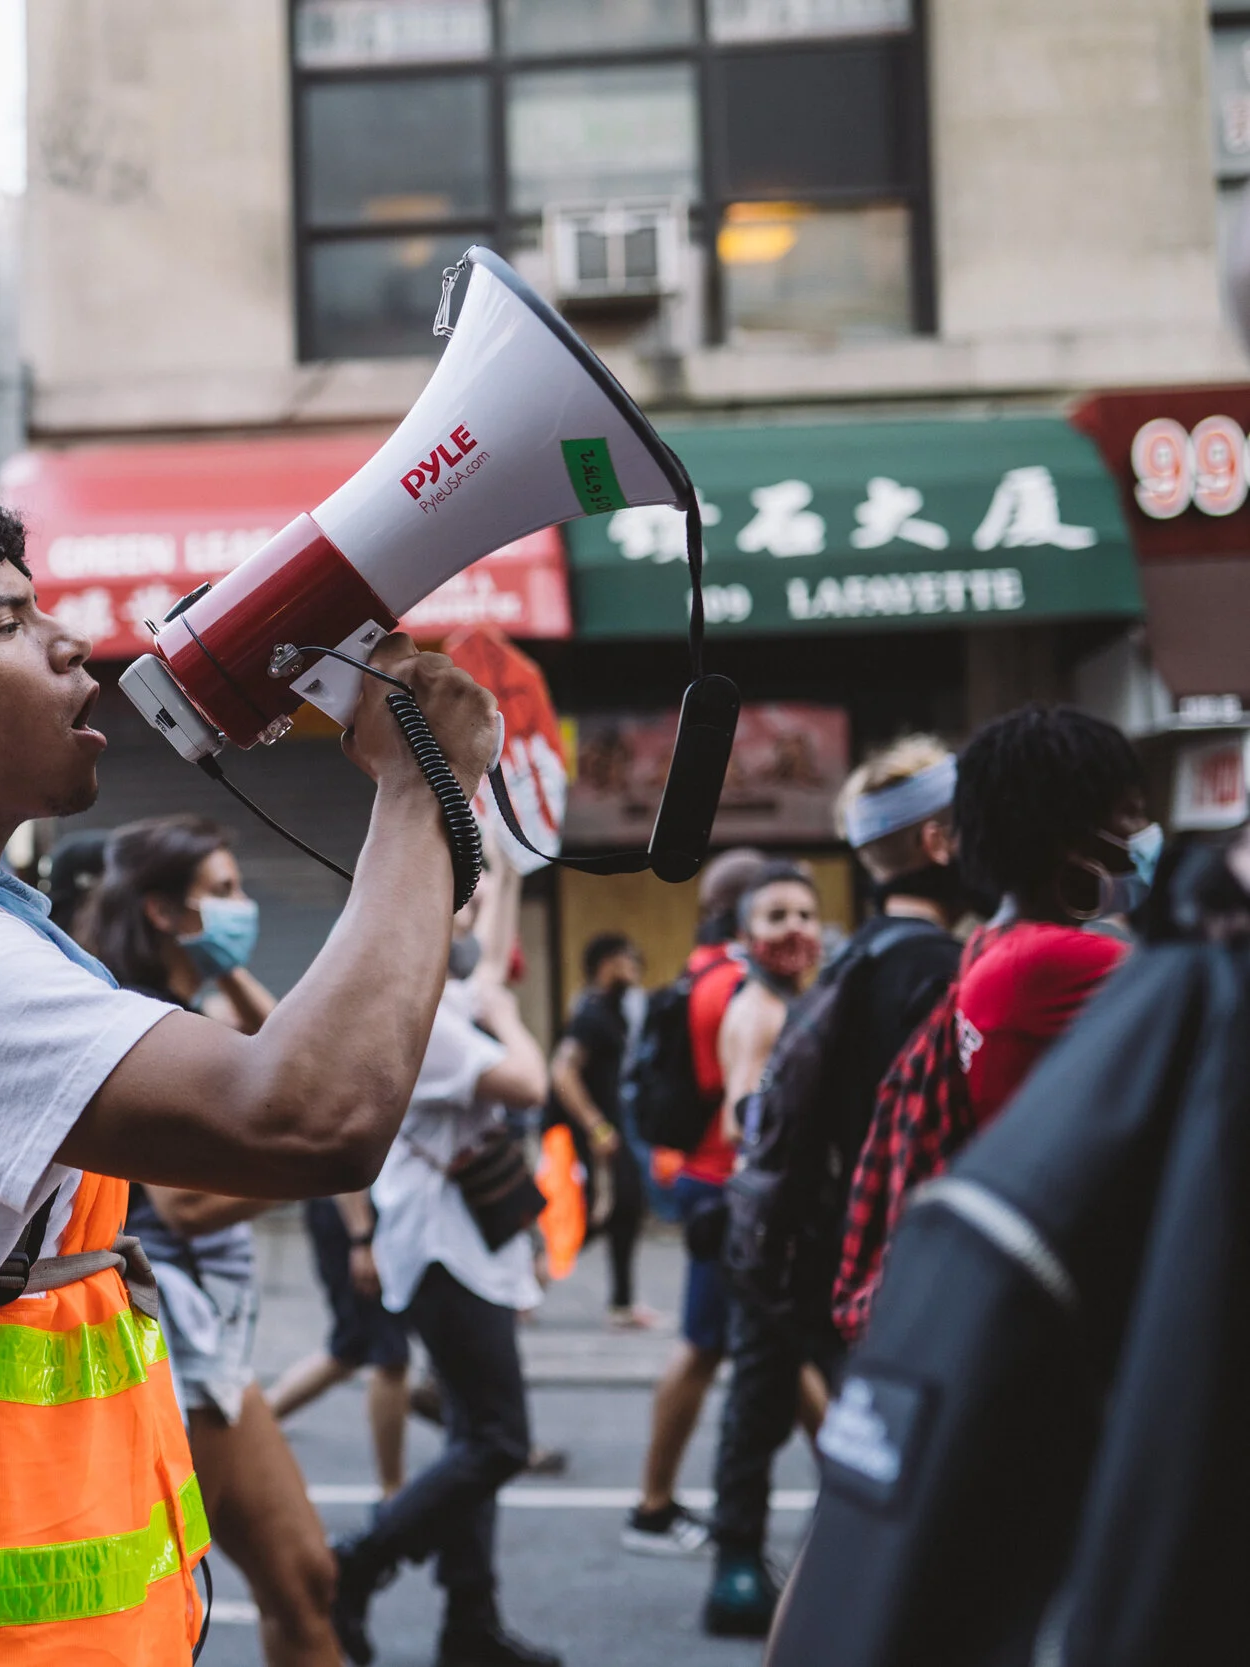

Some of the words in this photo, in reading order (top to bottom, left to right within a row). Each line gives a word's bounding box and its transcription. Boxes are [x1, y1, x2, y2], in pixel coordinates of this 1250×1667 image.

[400, 425, 478, 500] PYLE
[419, 451, 490, 514] PyleUSA.com
[1132, 415, 1250, 518] 99
[48, 533, 176, 579] GREEN
[184, 527, 277, 574] LEA
[786, 567, 1026, 620] LAFAYETTE
